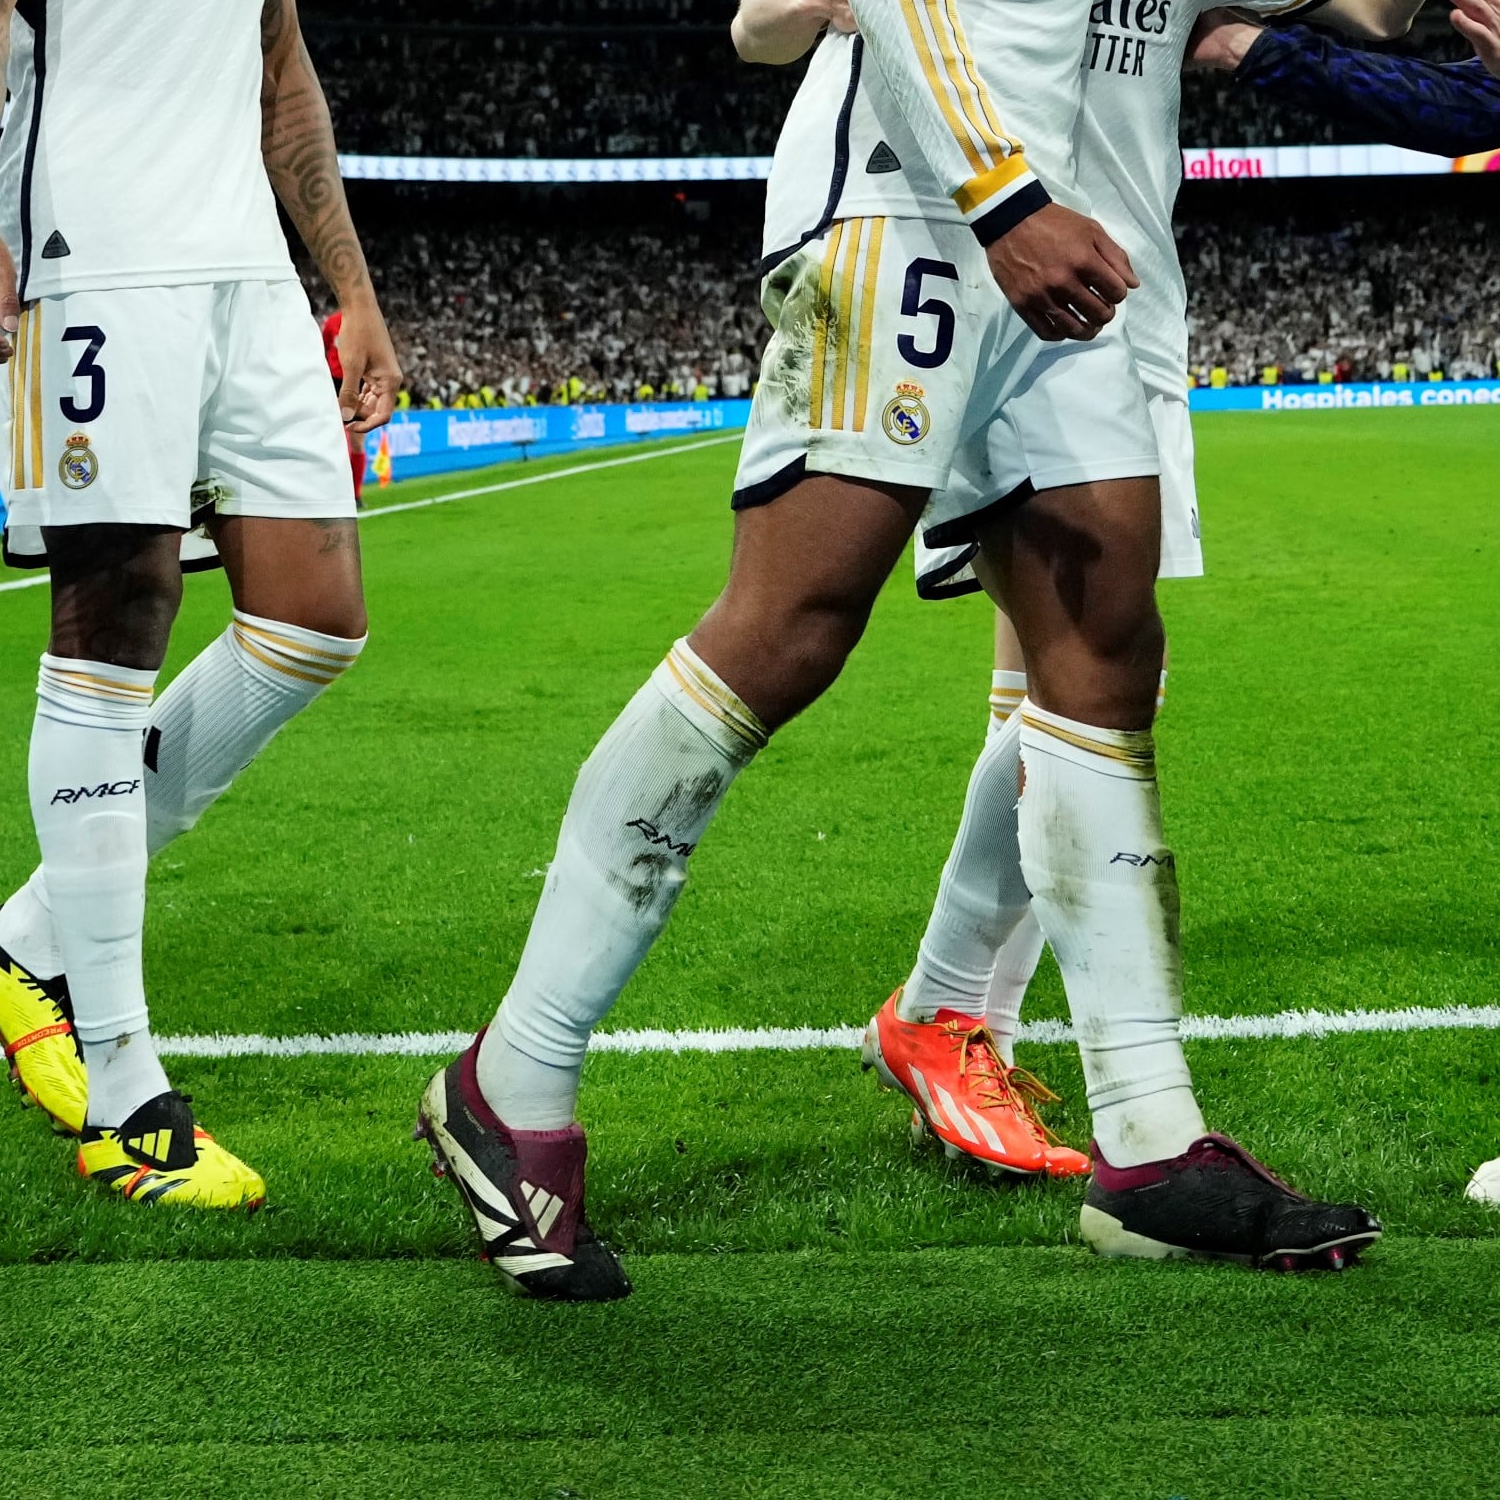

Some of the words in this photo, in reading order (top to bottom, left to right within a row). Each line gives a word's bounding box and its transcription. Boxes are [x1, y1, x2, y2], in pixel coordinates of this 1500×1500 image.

[1085, 33, 1146, 76] TTER
[1188, 148, 1263, 180] ahou
[897, 256, 959, 369] 5
[60, 325, 106, 424] 3
[1262, 386, 1412, 410] Hospitales
[1110, 852, 1173, 868] RM
